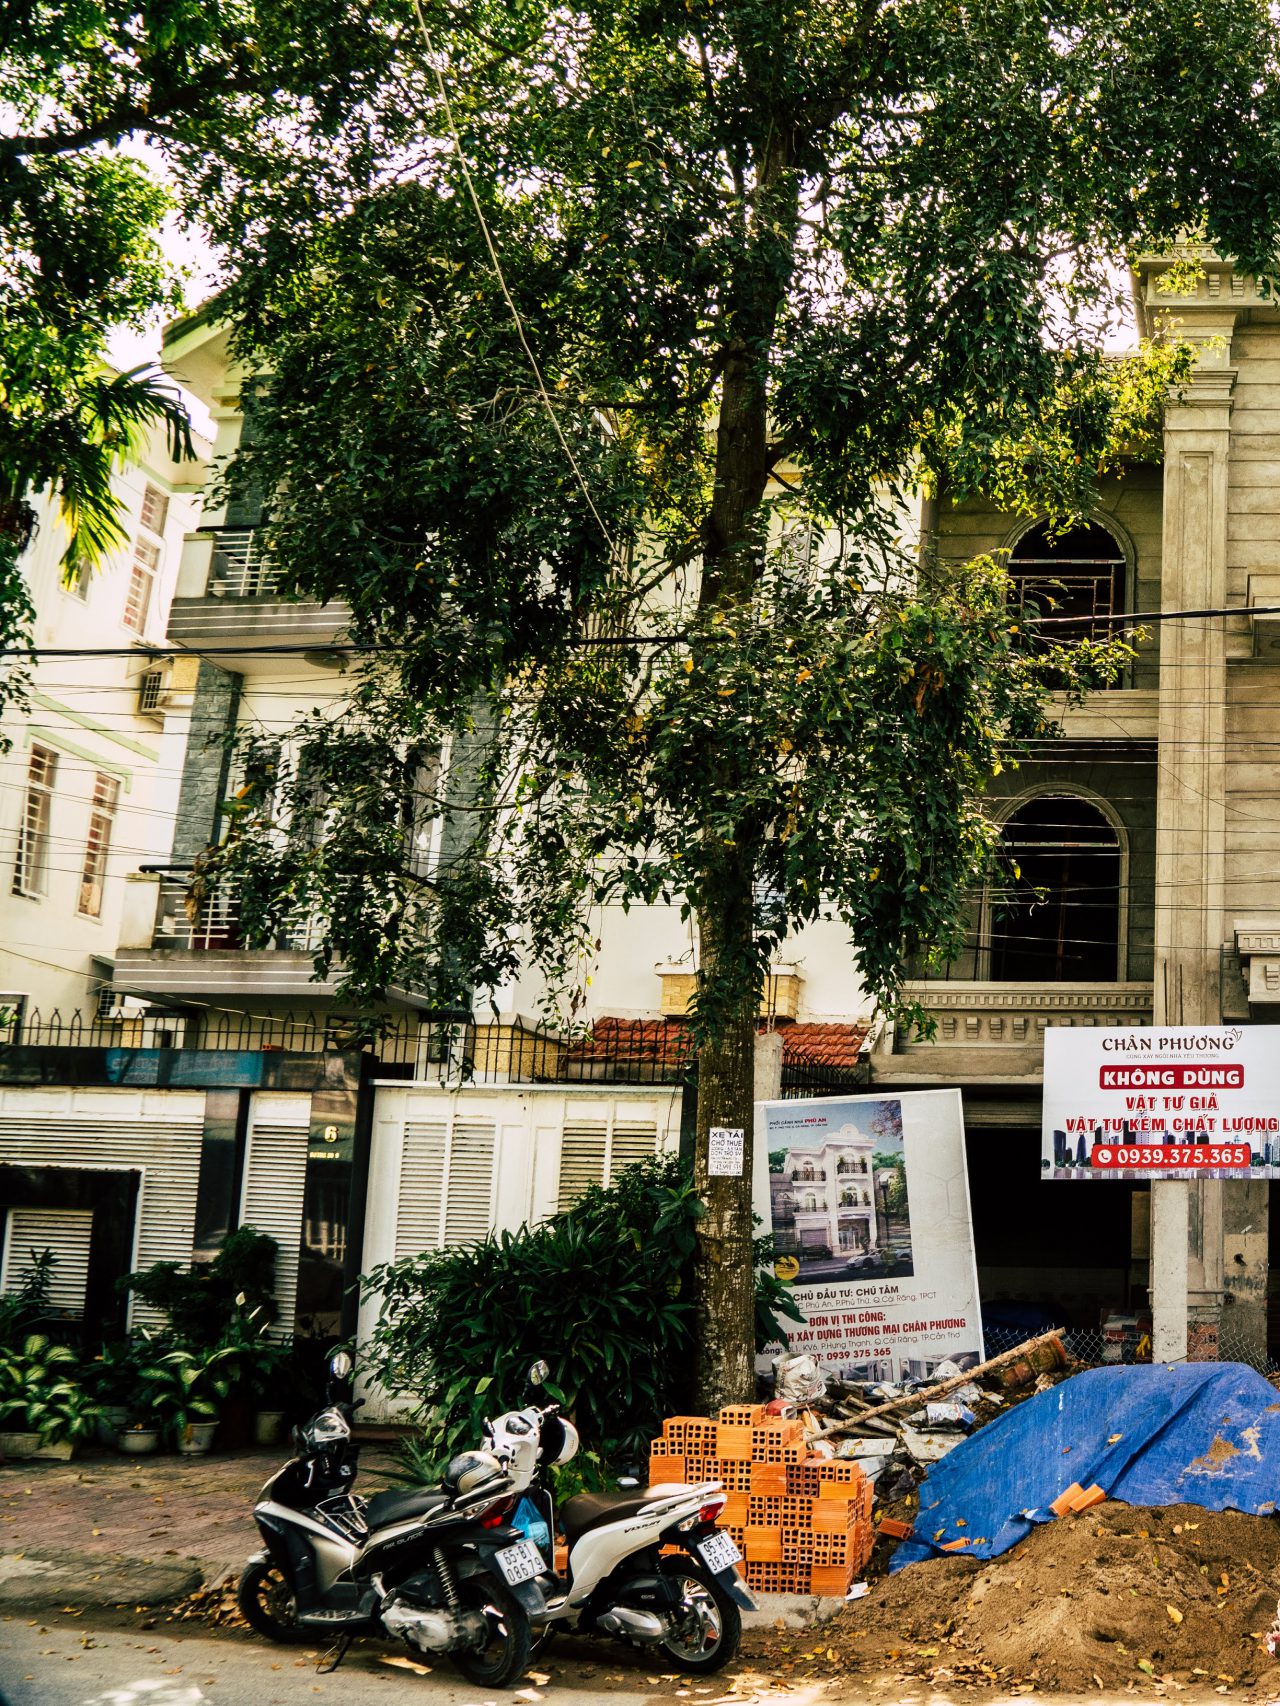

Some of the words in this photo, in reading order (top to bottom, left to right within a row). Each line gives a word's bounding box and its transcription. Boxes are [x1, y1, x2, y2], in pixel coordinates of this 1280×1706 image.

[1102, 1035, 1152, 1051] CHÂN
[1159, 1035, 1235, 1051] PHƯƠNG
[1103, 1068, 1175, 1086] KHÔNG
[1183, 1067, 1240, 1086] DÙNG
[1125, 1094, 1157, 1114] VẬT
[1162, 1095, 1186, 1111] TƯ
[1189, 1092, 1219, 1111] GIẢ
[1065, 1116, 1097, 1135] VẬT
[1102, 1117, 1124, 1133] TƯ
[1129, 1116, 1167, 1133] KÉM
[1172, 1113, 1216, 1133] CHẤT
[1222, 1115, 1280, 1135] LƯỢNG
[324, 1125, 338, 1143] 6
[711, 1131, 726, 1139] XE
[1117, 1148, 1244, 1164] 0939.375.365
[793, 1290, 814, 1302] CHỦ
[816, 1288, 837, 1300] ĐẦU
[838, 1288, 853, 1298] TƯ:
[855, 1286, 877, 1297] CHÚ
[878, 1284, 900, 1295] TÂM
[919, 1291, 937, 1300] TPCT
[809, 1315, 829, 1328] ĐƠN
[830, 1315, 840, 1328] VỊ
[841, 1314, 856, 1325] THI
[858, 1311, 887, 1324] CÔNG:
[797, 1329, 815, 1343] XÂY
[816, 1328, 843, 1342] DỰNG
[844, 1324, 880, 1338] THƯƠNG
[882, 1323, 901, 1336] MẠI
[902, 1320, 928, 1334] CHÂN
[929, 1317, 967, 1331] PHƯƠNG
[826, 1350, 851, 1361] 0939
[853, 1349, 872, 1359] 375
[873, 1347, 892, 1358] 365
[506, 1556, 544, 1583] 086.79
